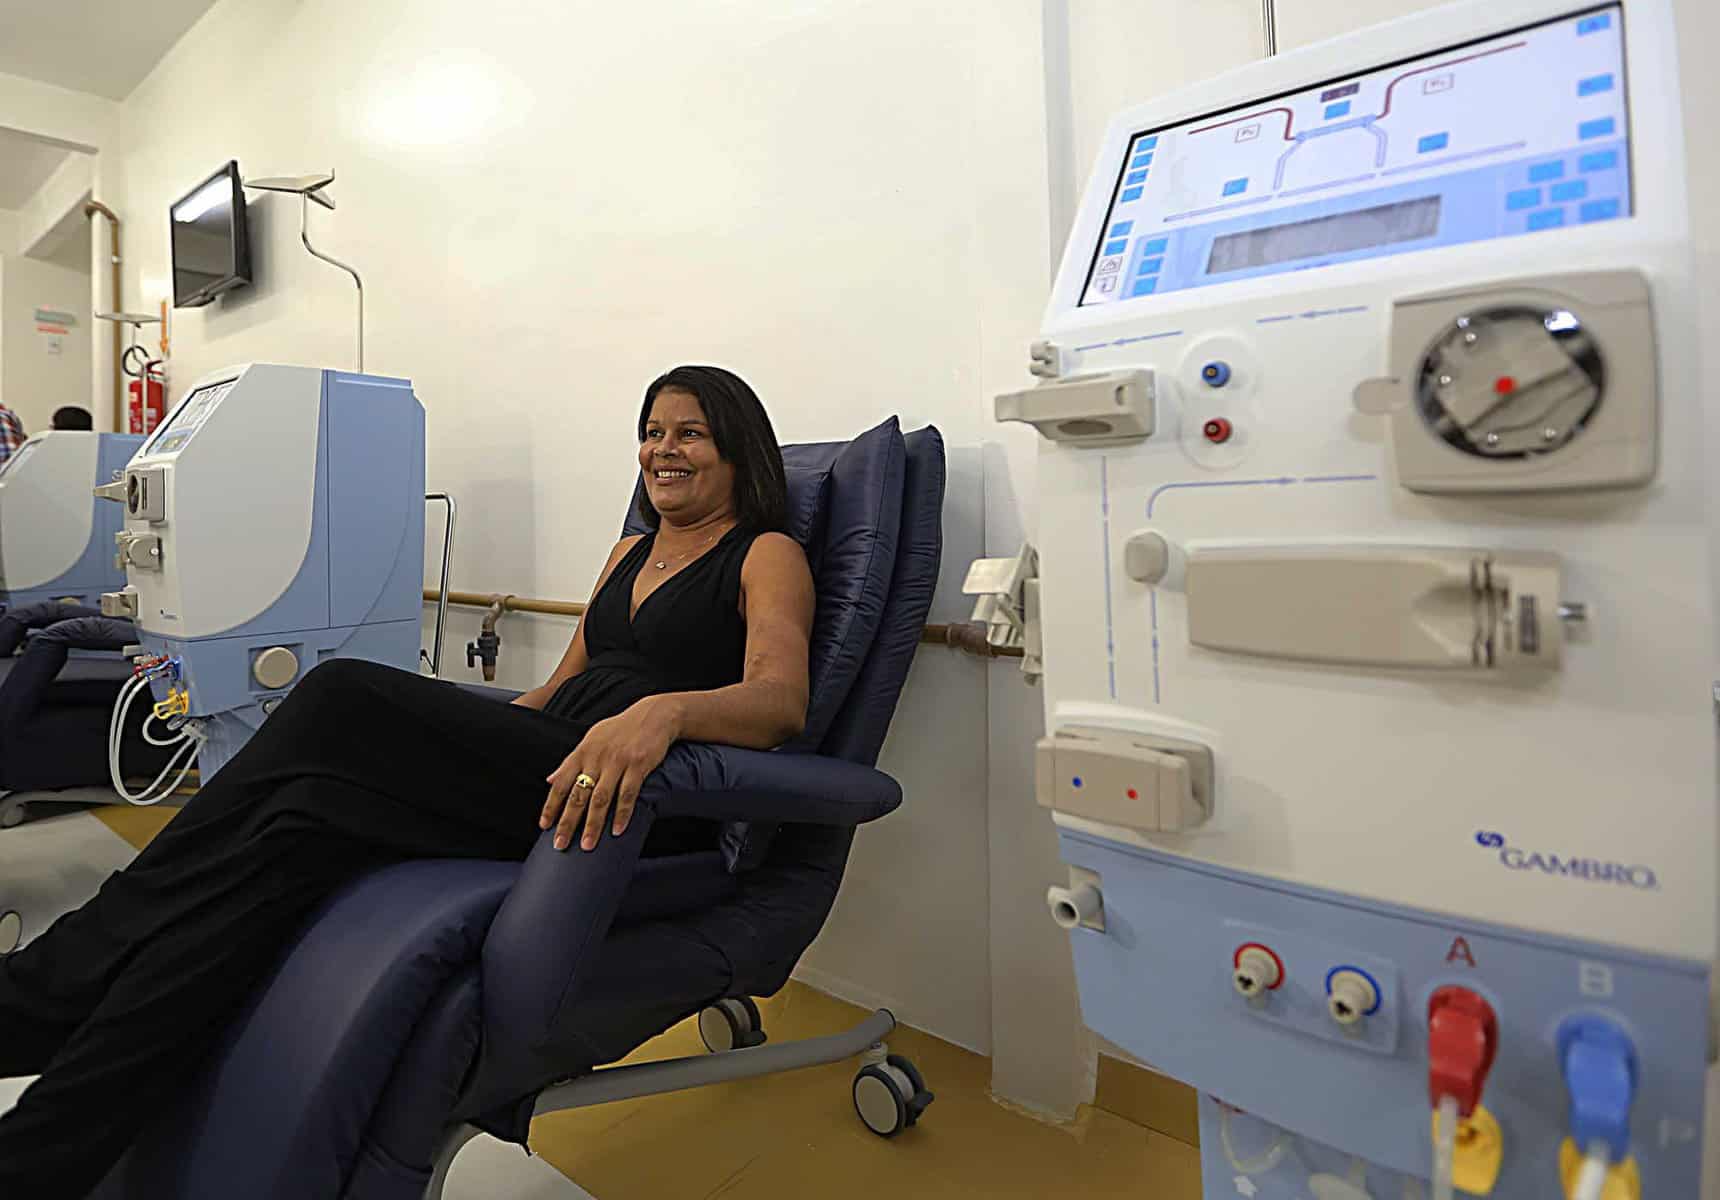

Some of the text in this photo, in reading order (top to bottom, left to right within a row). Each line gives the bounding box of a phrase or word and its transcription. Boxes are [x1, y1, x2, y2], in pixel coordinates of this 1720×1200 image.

[1500, 848, 1657, 889] GAMBRO
[1446, 934, 1476, 967] A
[1580, 960, 1613, 996] B
